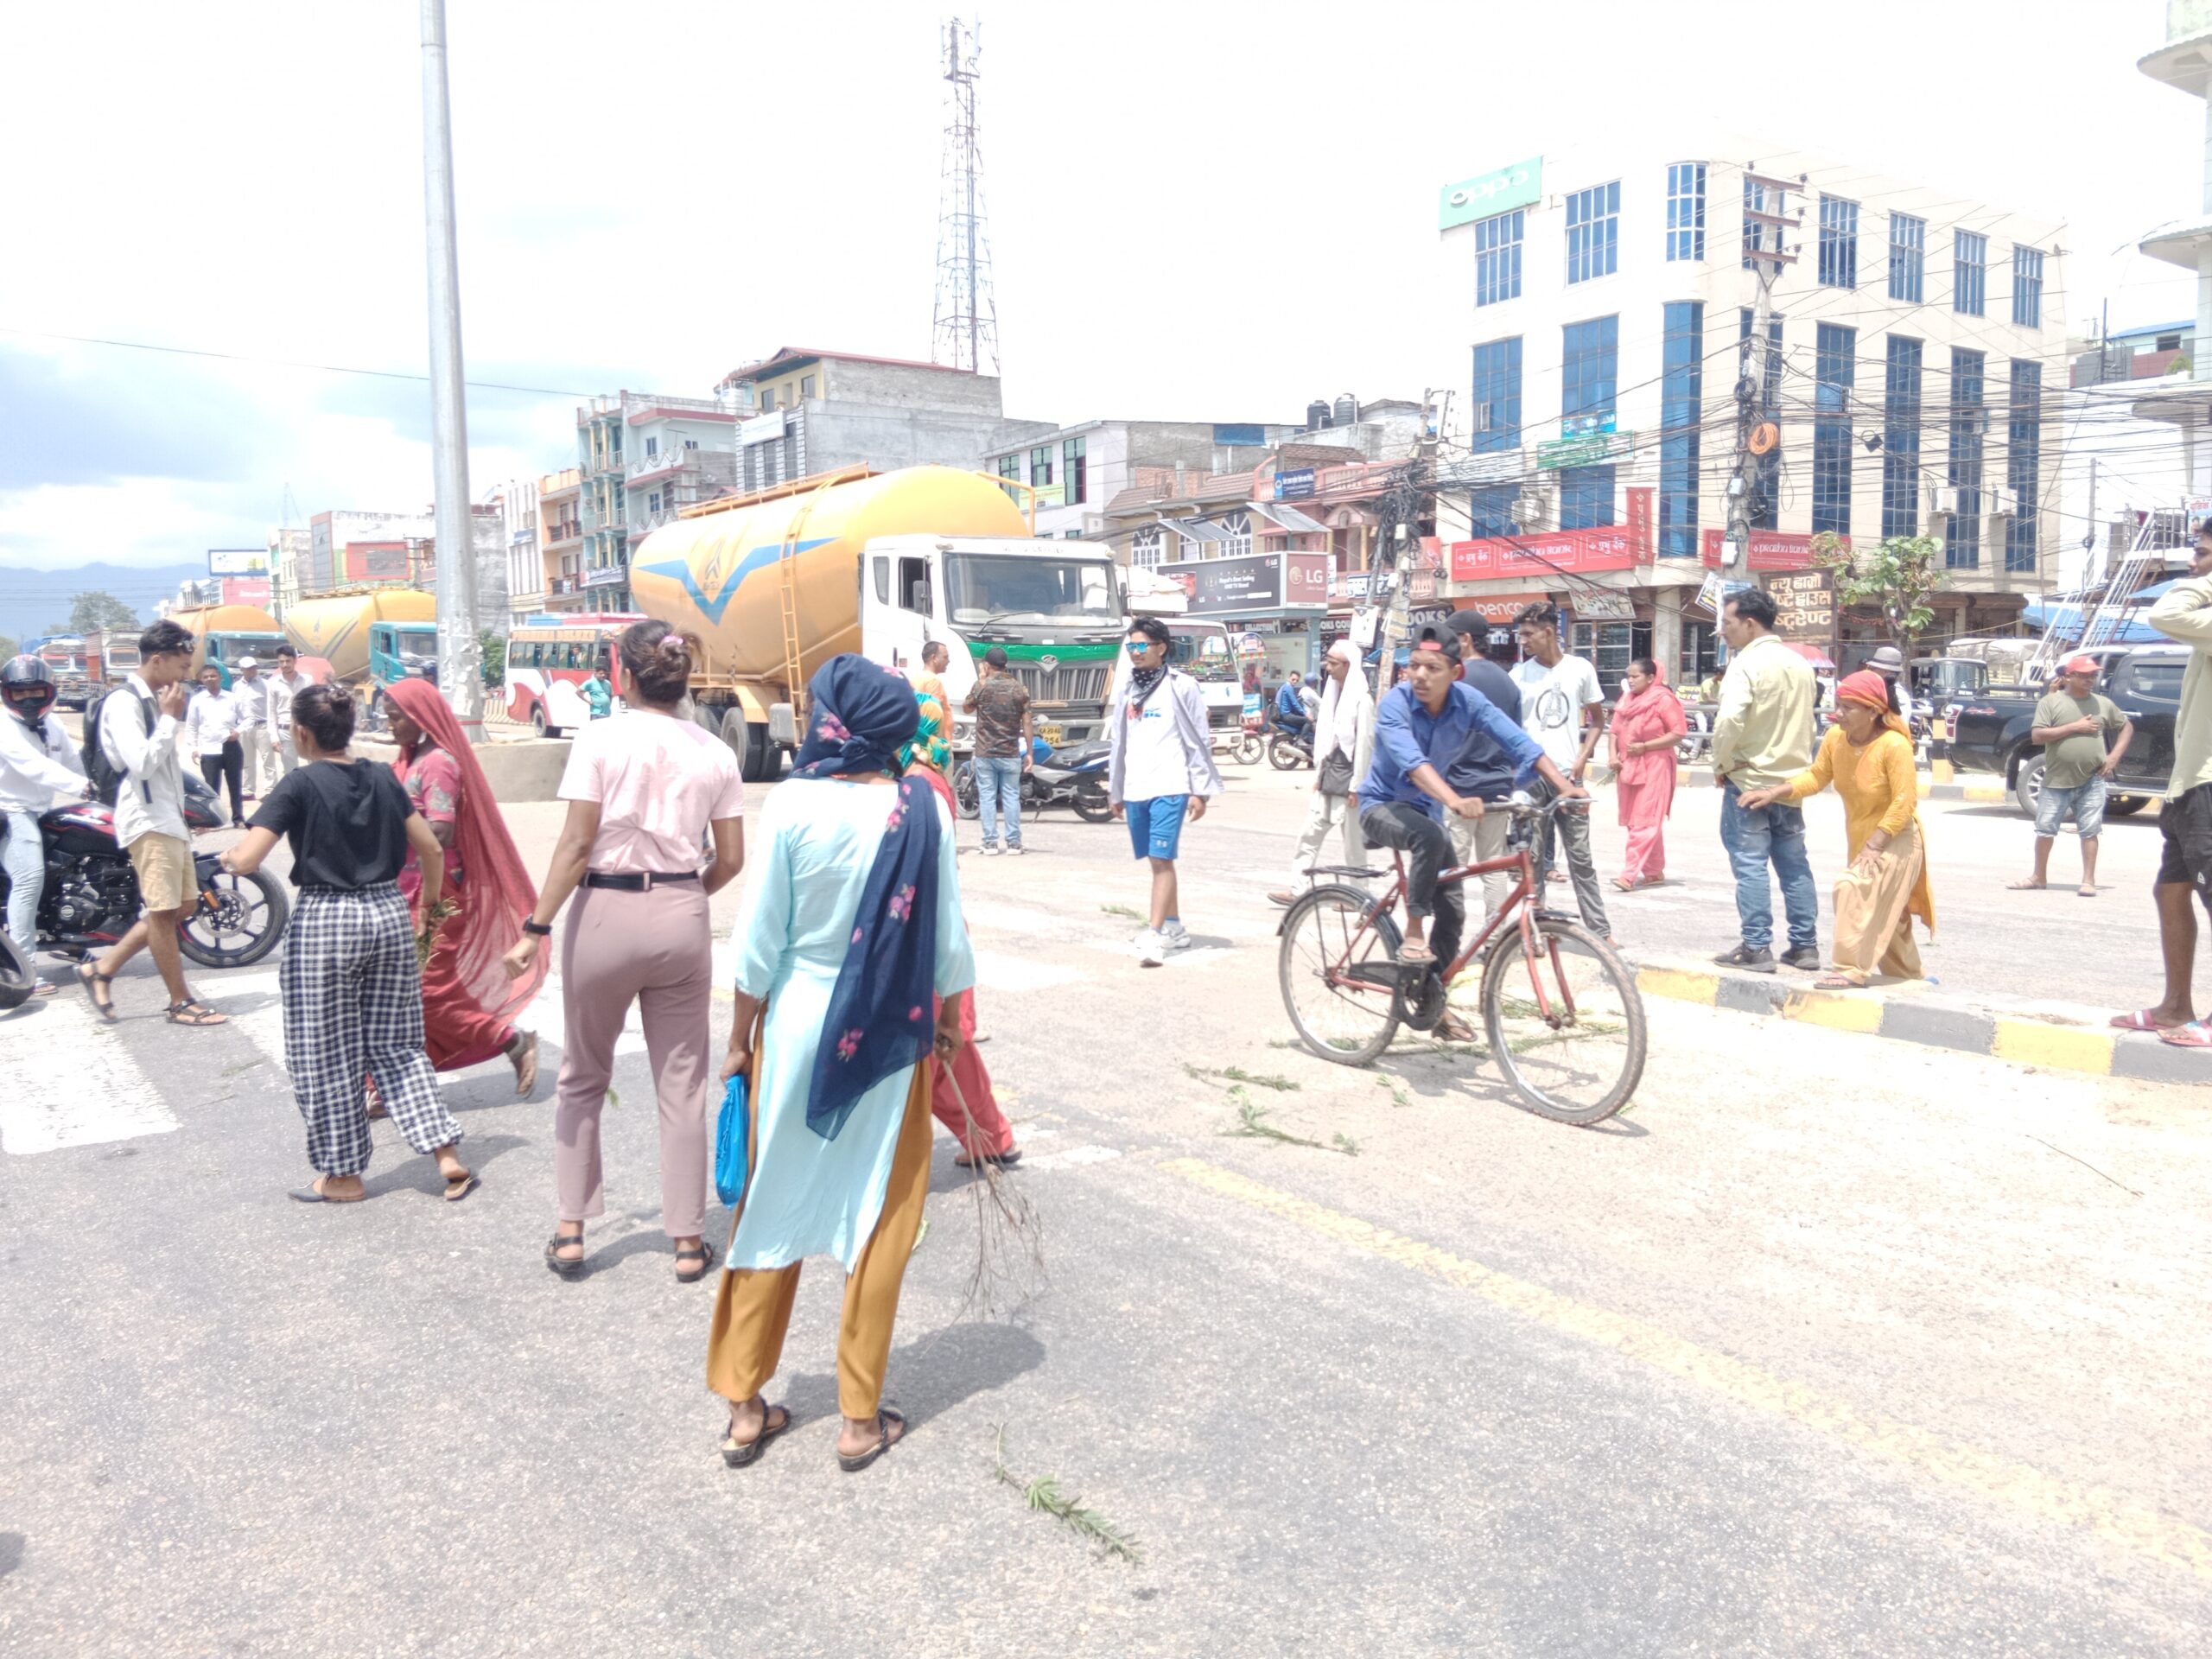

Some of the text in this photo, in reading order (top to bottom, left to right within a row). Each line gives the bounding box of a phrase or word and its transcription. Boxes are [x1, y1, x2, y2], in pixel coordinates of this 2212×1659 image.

[1306, 569, 1324, 583] LG
[1795, 590, 1832, 607] हाउस
[1474, 601, 1524, 616] benco
[1408, 610, 1446, 626] OOKS
[1774, 608, 1833, 631] ष्टूरेण्ट
